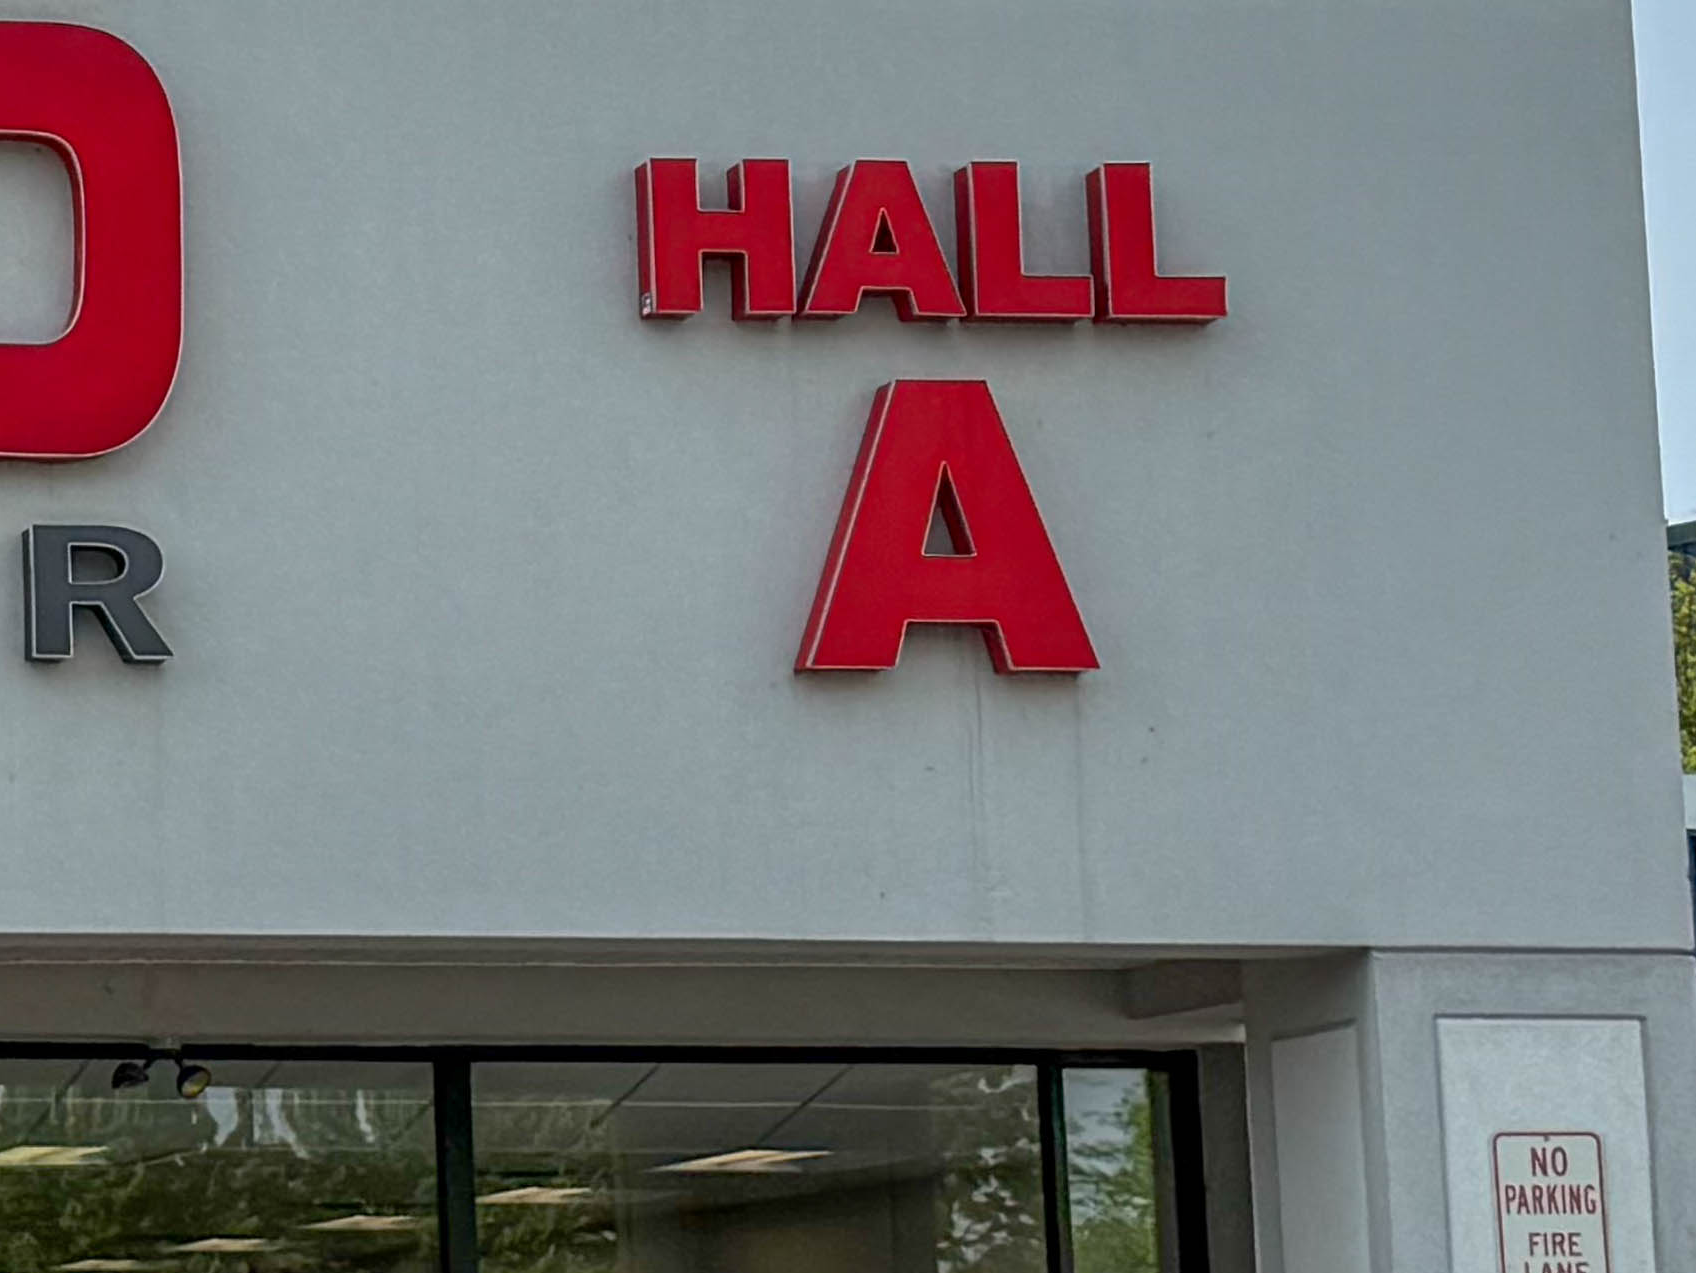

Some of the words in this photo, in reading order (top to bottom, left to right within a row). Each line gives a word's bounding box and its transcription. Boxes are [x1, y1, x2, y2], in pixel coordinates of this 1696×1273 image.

[635, 157, 1227, 324] HALL
[794, 378, 1101, 674] A
[1530, 1146, 1569, 1177] NO
[1505, 1184, 1597, 1215] PARKING
[1528, 1232, 1583, 1258] FIRE
